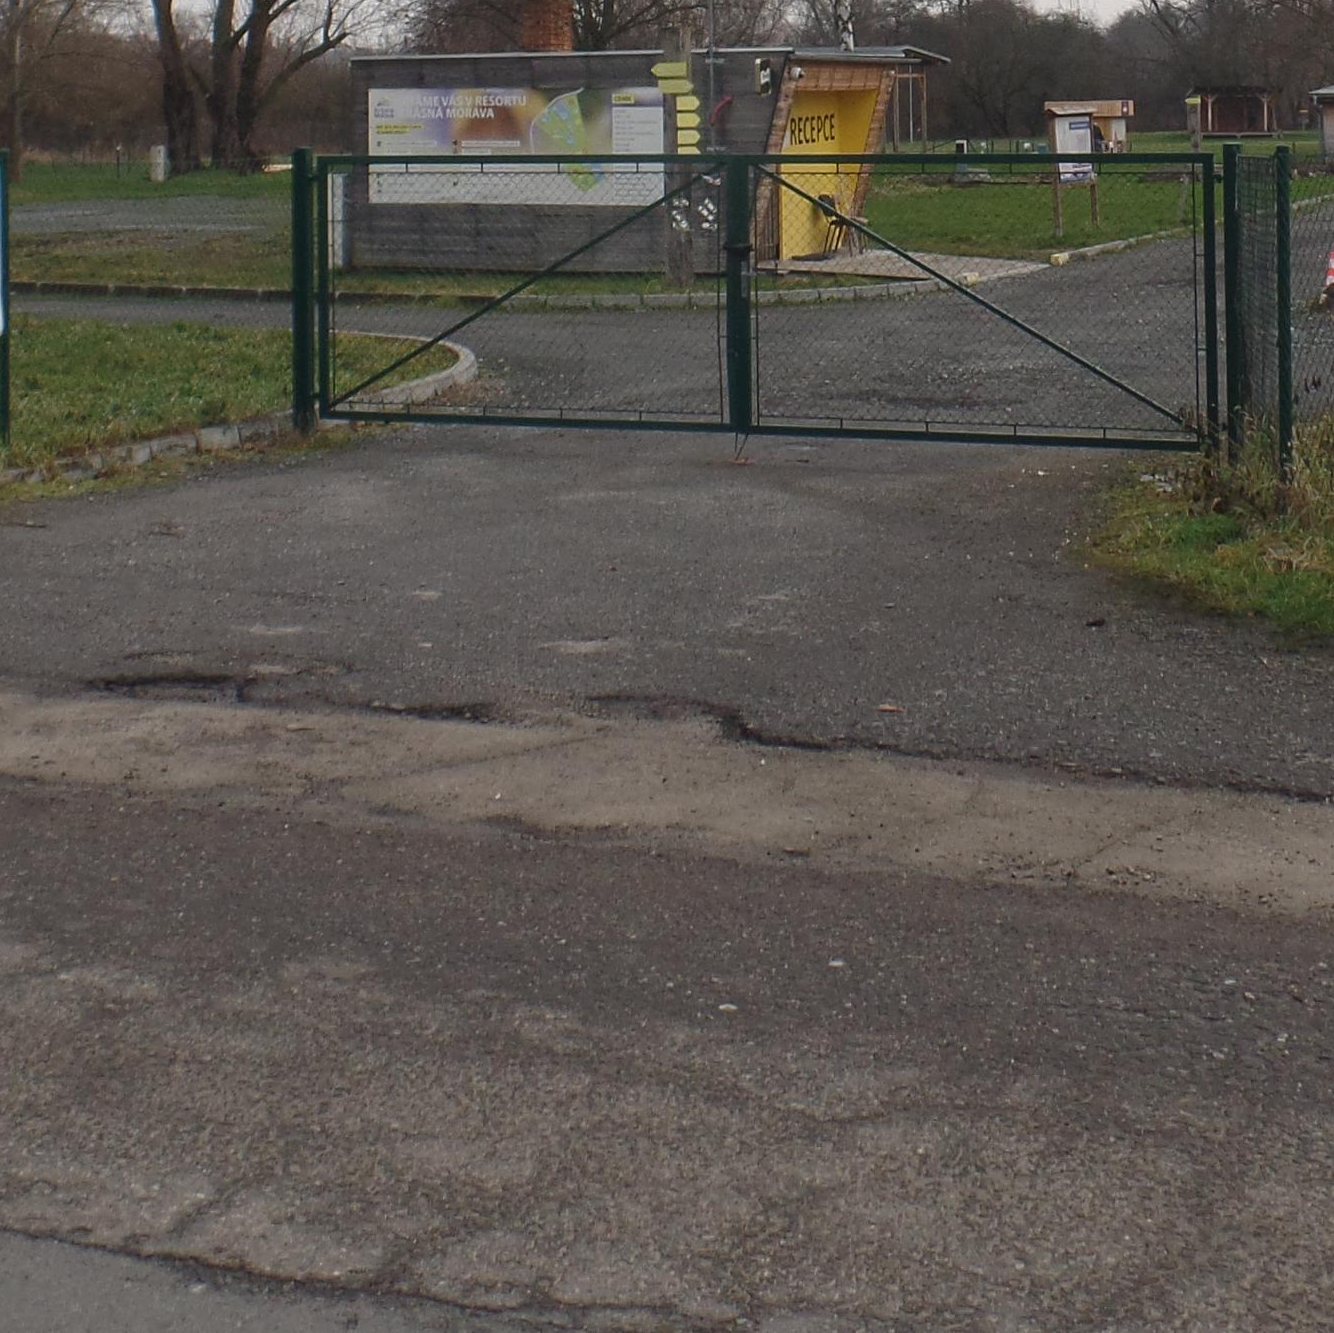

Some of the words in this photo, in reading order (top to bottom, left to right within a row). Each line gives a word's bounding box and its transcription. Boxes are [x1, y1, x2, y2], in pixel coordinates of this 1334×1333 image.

[476, 95, 526, 107] RESORTU
[446, 106, 495, 119] MORAVA
[790, 114, 835, 146] RECEPCE
